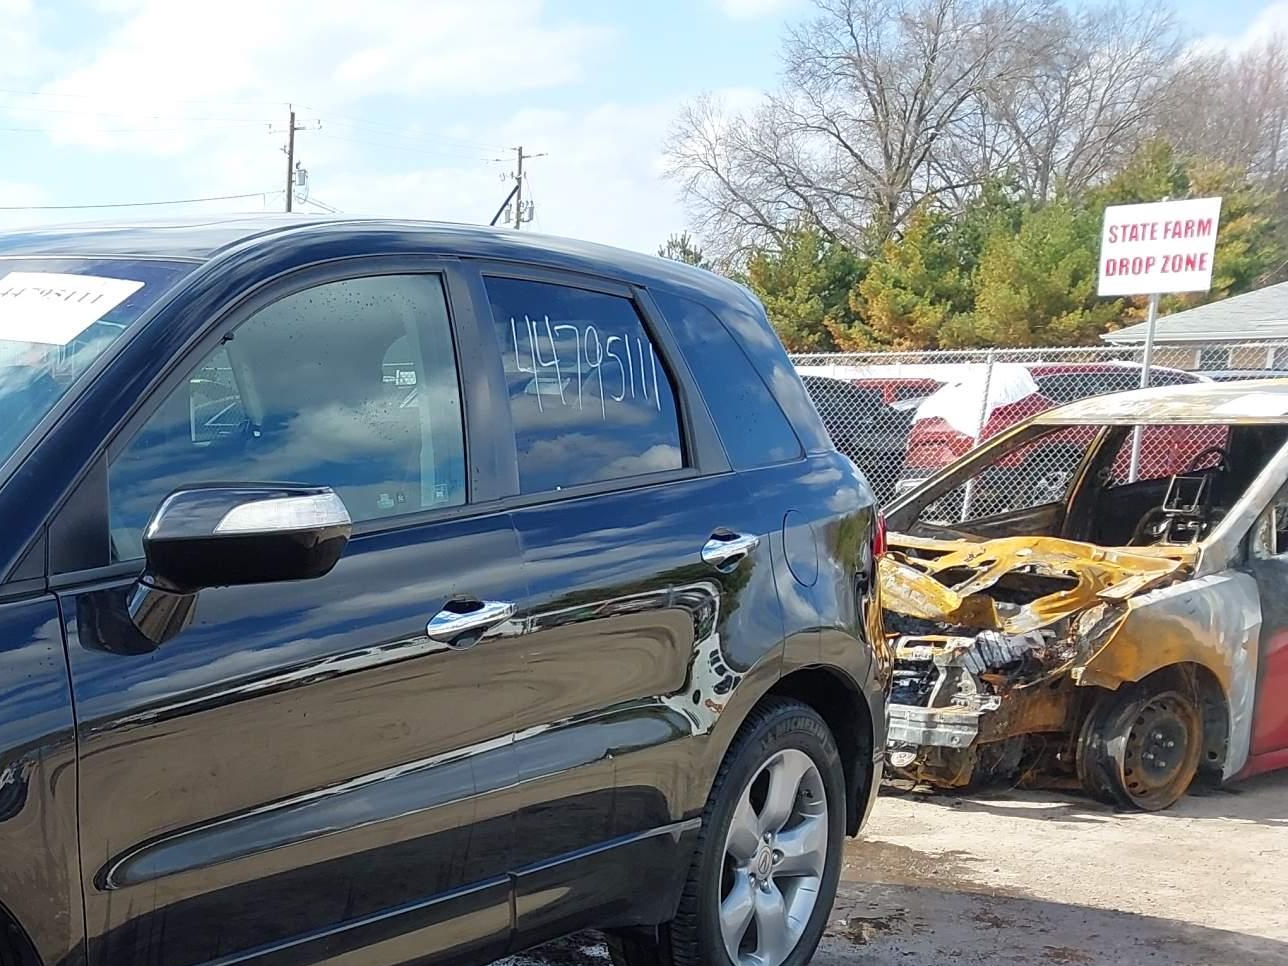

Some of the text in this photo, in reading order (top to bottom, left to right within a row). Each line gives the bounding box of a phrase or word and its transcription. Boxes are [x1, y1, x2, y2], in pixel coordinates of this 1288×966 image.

[1108, 217, 1213, 243] STATE FARM
[1105, 252, 1209, 276] DROP ZONE
[511, 315, 662, 423] 44795111
